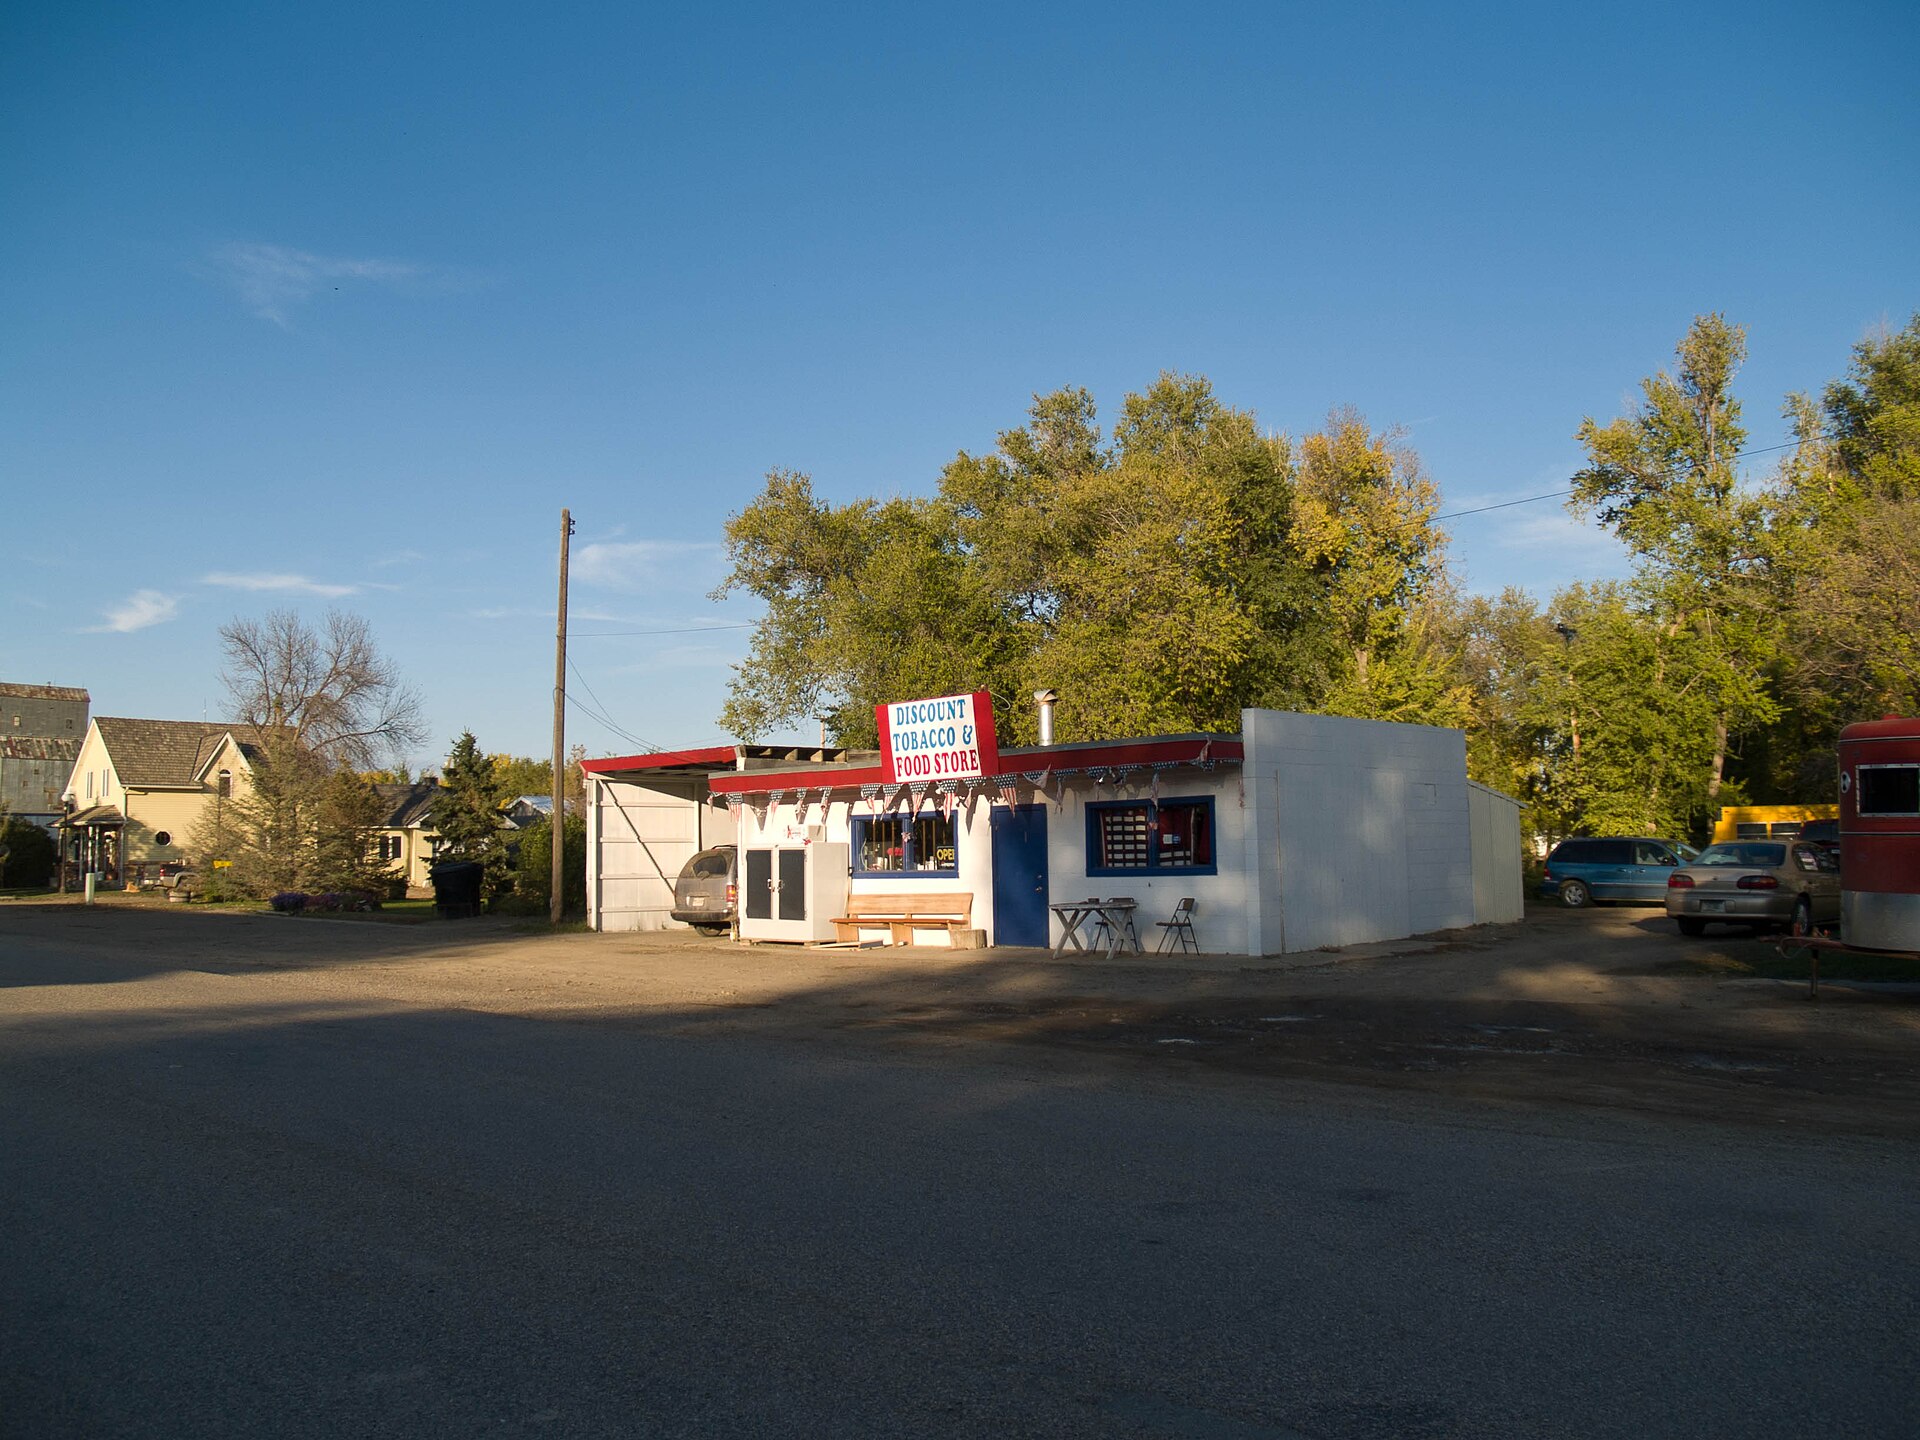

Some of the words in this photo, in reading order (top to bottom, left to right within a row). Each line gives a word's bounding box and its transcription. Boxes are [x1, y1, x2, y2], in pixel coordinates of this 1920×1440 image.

[896, 699, 966, 726] DISCOUNT
[893, 726, 956, 752] TOBACCO
[962, 724, 973, 746] &
[896, 754, 931, 777] FOOD
[934, 749, 979, 774] STORE
[937, 849, 955, 860] OPE
